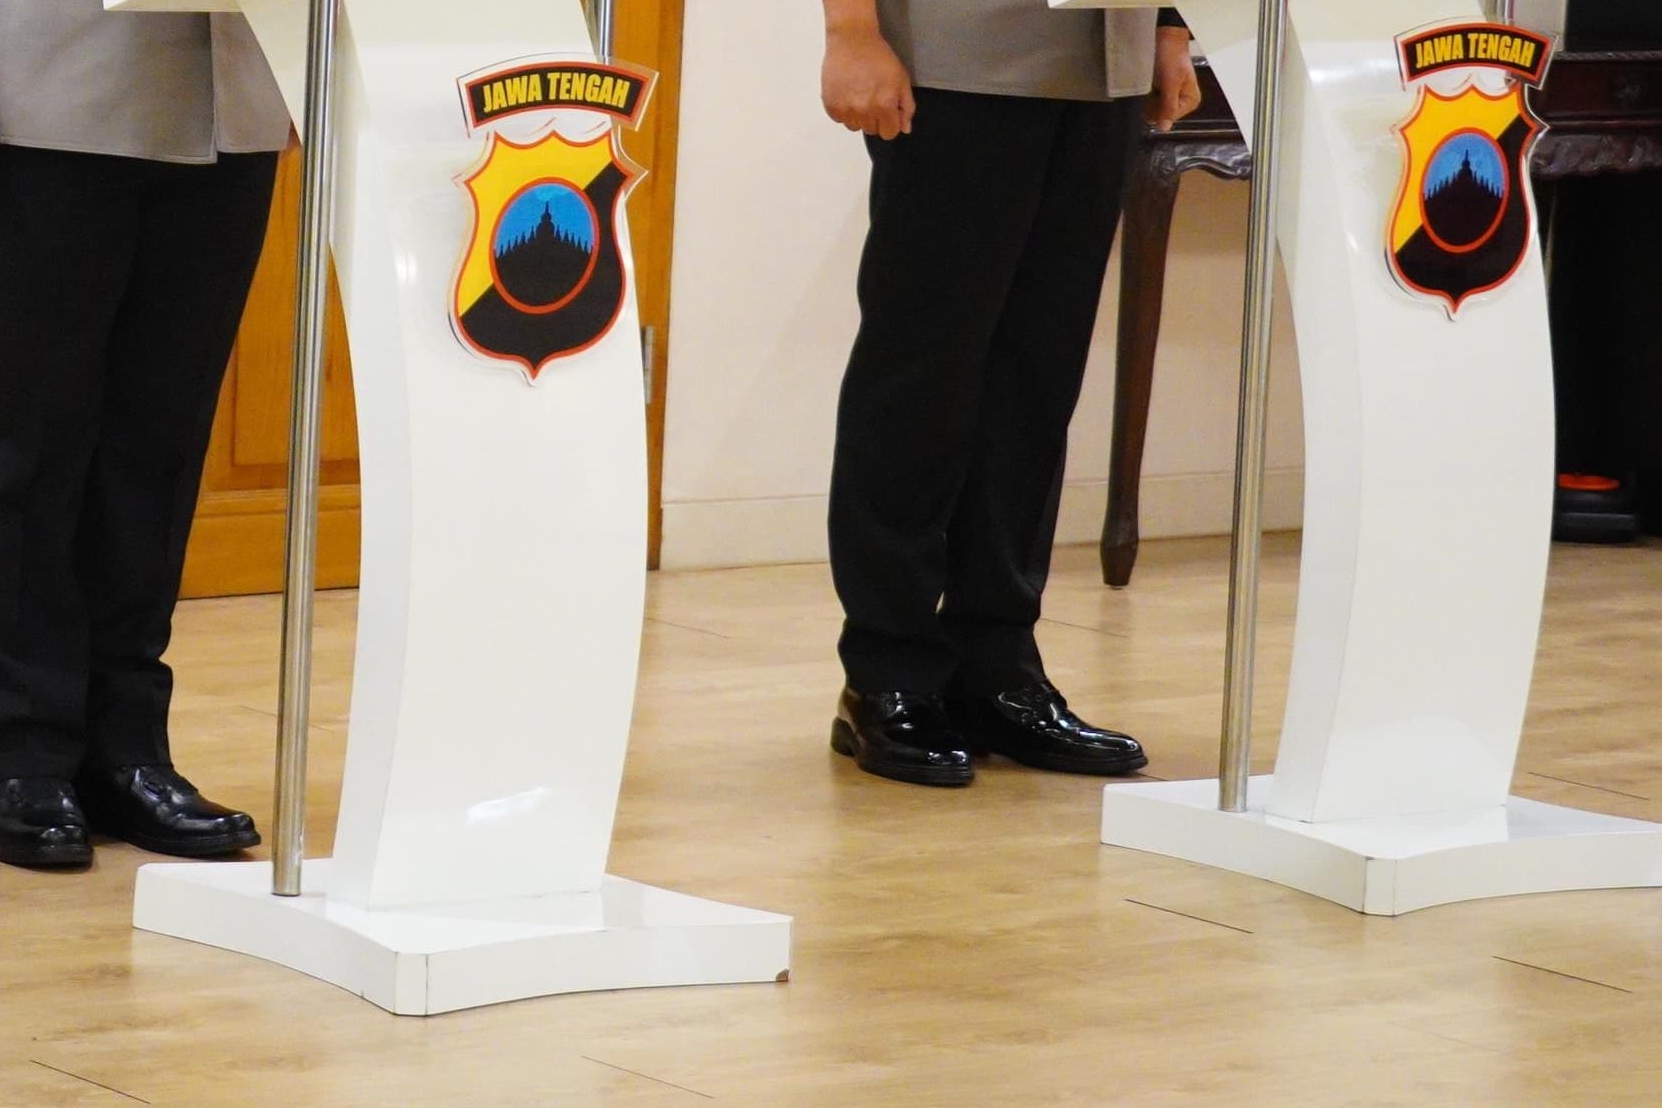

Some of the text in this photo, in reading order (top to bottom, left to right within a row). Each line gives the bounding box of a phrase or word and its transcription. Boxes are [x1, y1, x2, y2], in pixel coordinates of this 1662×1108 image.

[1415, 33, 1536, 69] JAWA TENGAH
[483, 72, 631, 113] JAWA TENGAH
